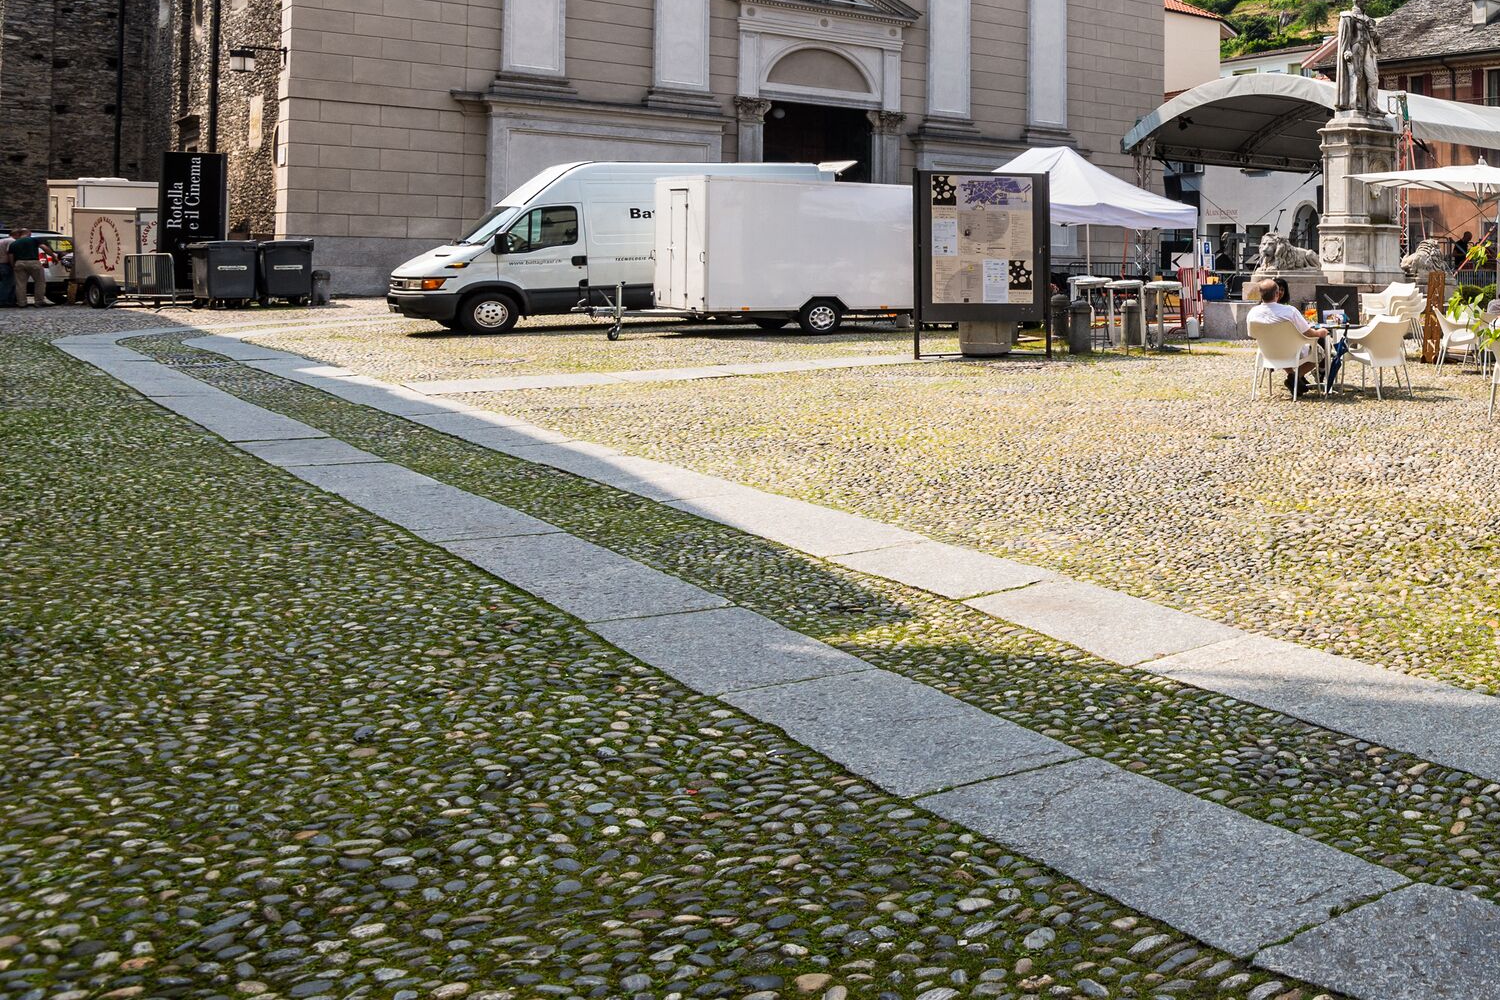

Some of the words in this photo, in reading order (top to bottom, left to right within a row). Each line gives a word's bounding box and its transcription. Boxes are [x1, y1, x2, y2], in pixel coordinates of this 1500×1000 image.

[184, 156, 202, 207] Cinema
[166, 181, 184, 230] Rotella
[184, 210, 200, 220] il
[189, 222, 200, 230] e
